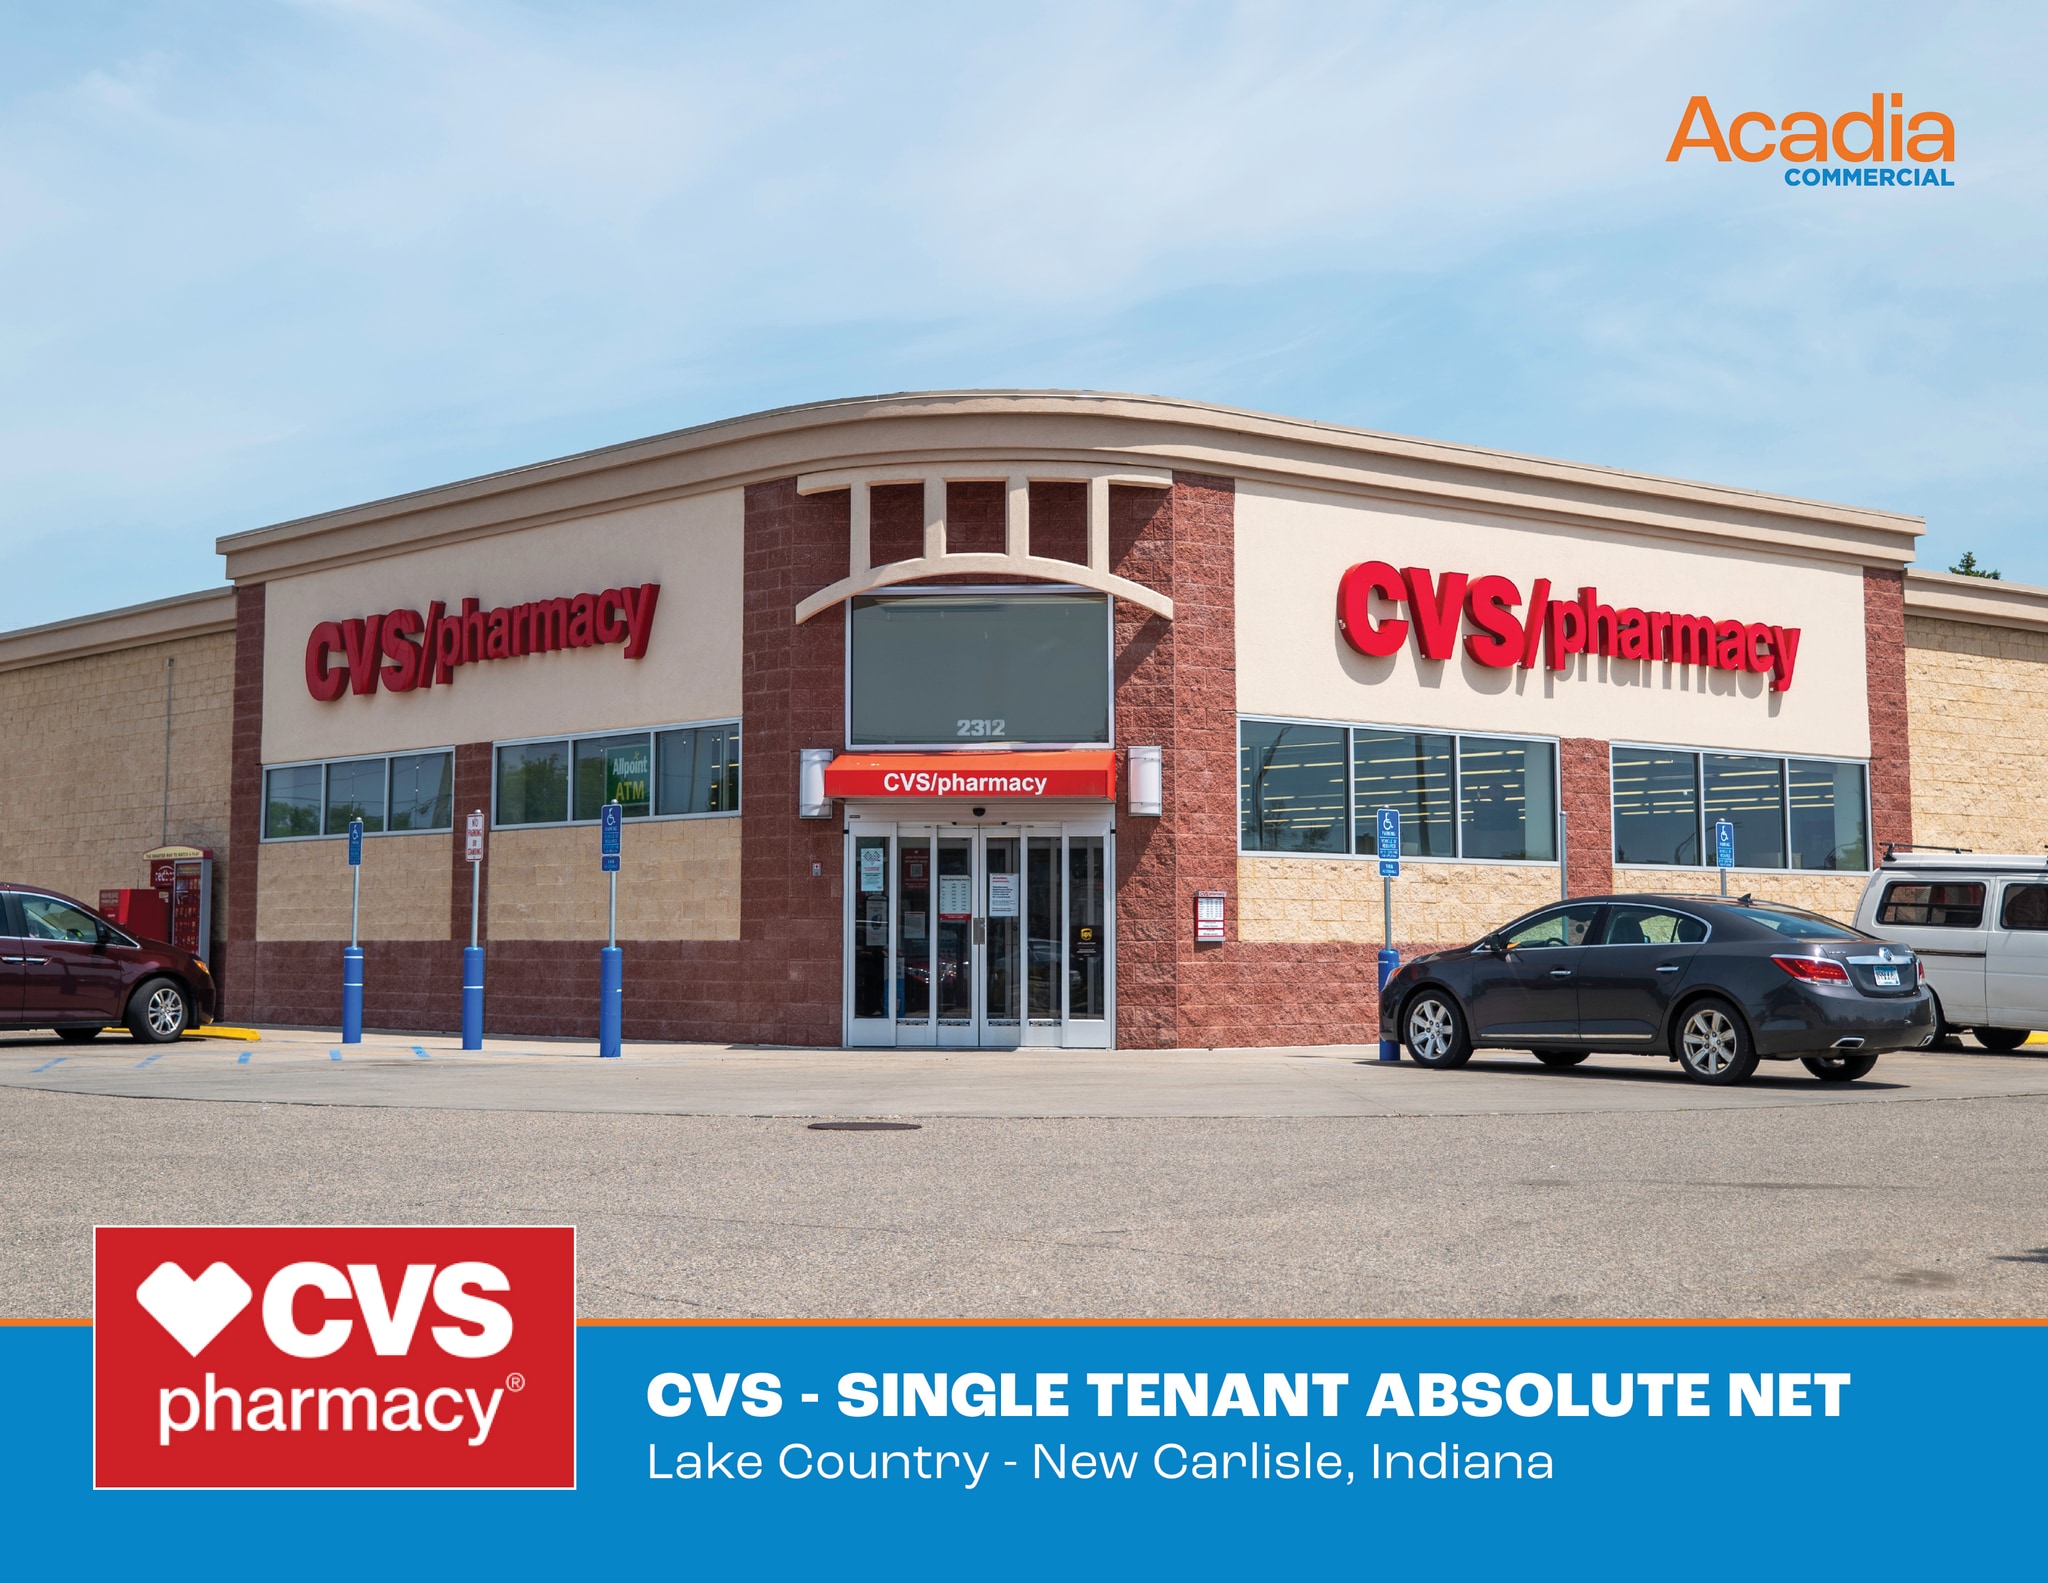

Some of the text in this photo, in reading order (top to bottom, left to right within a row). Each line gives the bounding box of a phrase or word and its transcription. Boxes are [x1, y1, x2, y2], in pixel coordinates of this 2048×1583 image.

[1337, 560, 1801, 692] CVS/pharmacy
[305, 583, 660, 701] CVS/pharmacy
[957, 719, 1006, 736] 2312
[612, 756, 648, 778] Allpoint
[615, 780, 645, 800] ATM
[883, 772, 1047, 796] CVS/pharmacy
